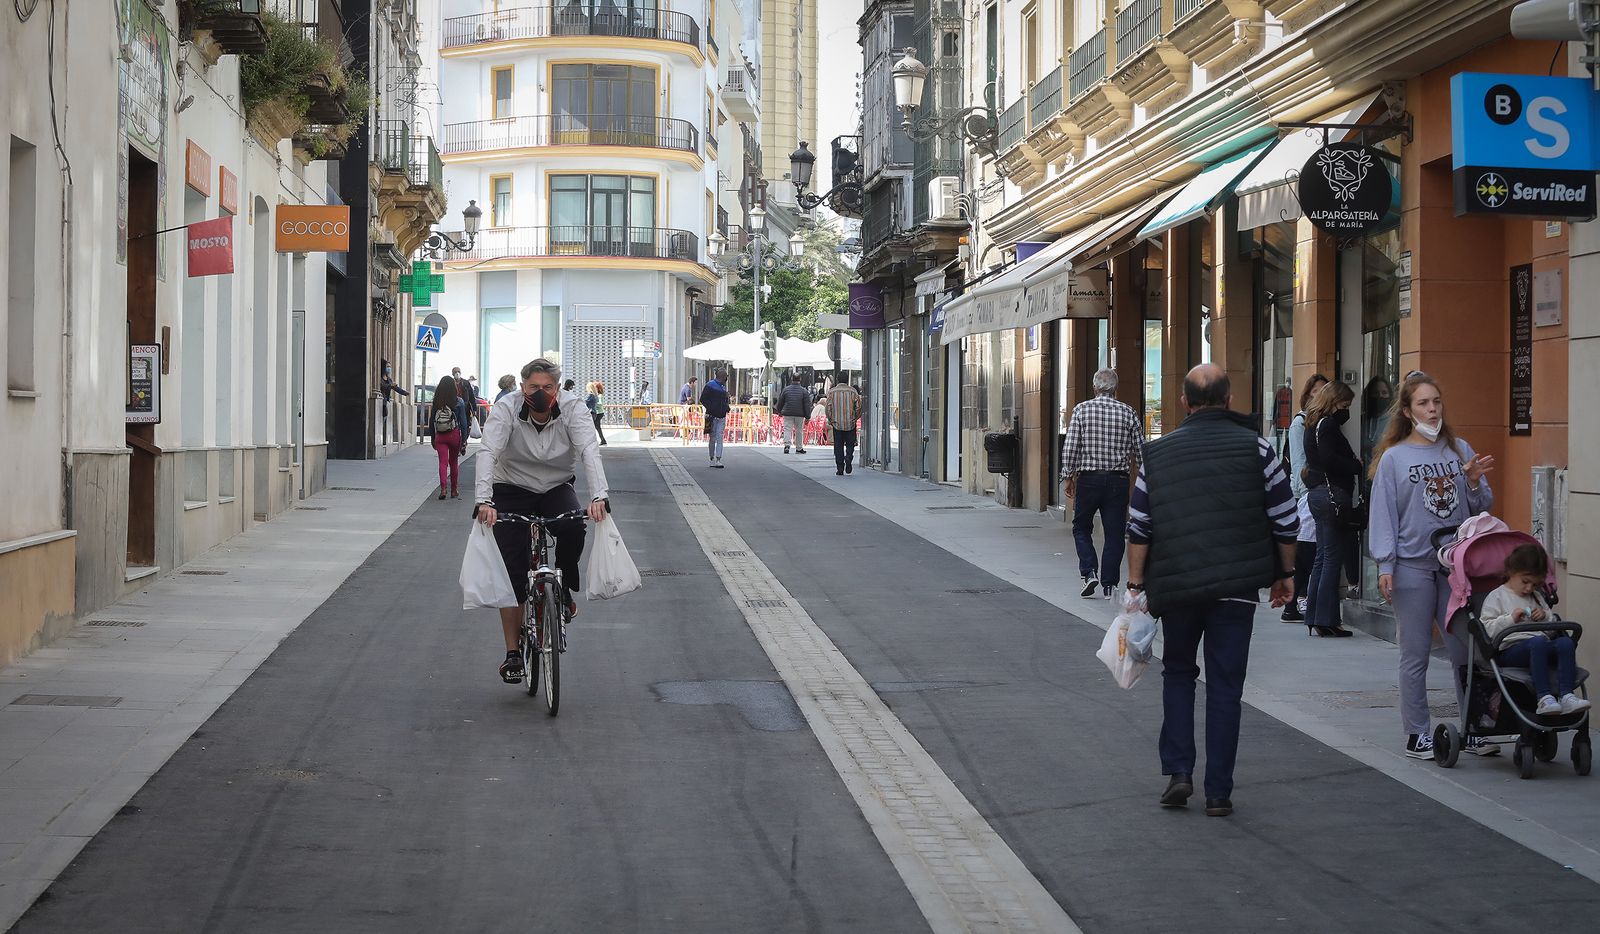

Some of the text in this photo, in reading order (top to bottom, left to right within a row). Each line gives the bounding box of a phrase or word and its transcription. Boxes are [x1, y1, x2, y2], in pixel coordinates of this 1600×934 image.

[1495, 94, 1570, 159] B S
[1512, 182, 1587, 202] ServiRed
[1310, 210, 1379, 220] ALPARGATERÍA
[281, 221, 348, 236] GOCCO
[189, 235, 229, 251] MOSTO
[1068, 282, 1105, 297] Tamara
